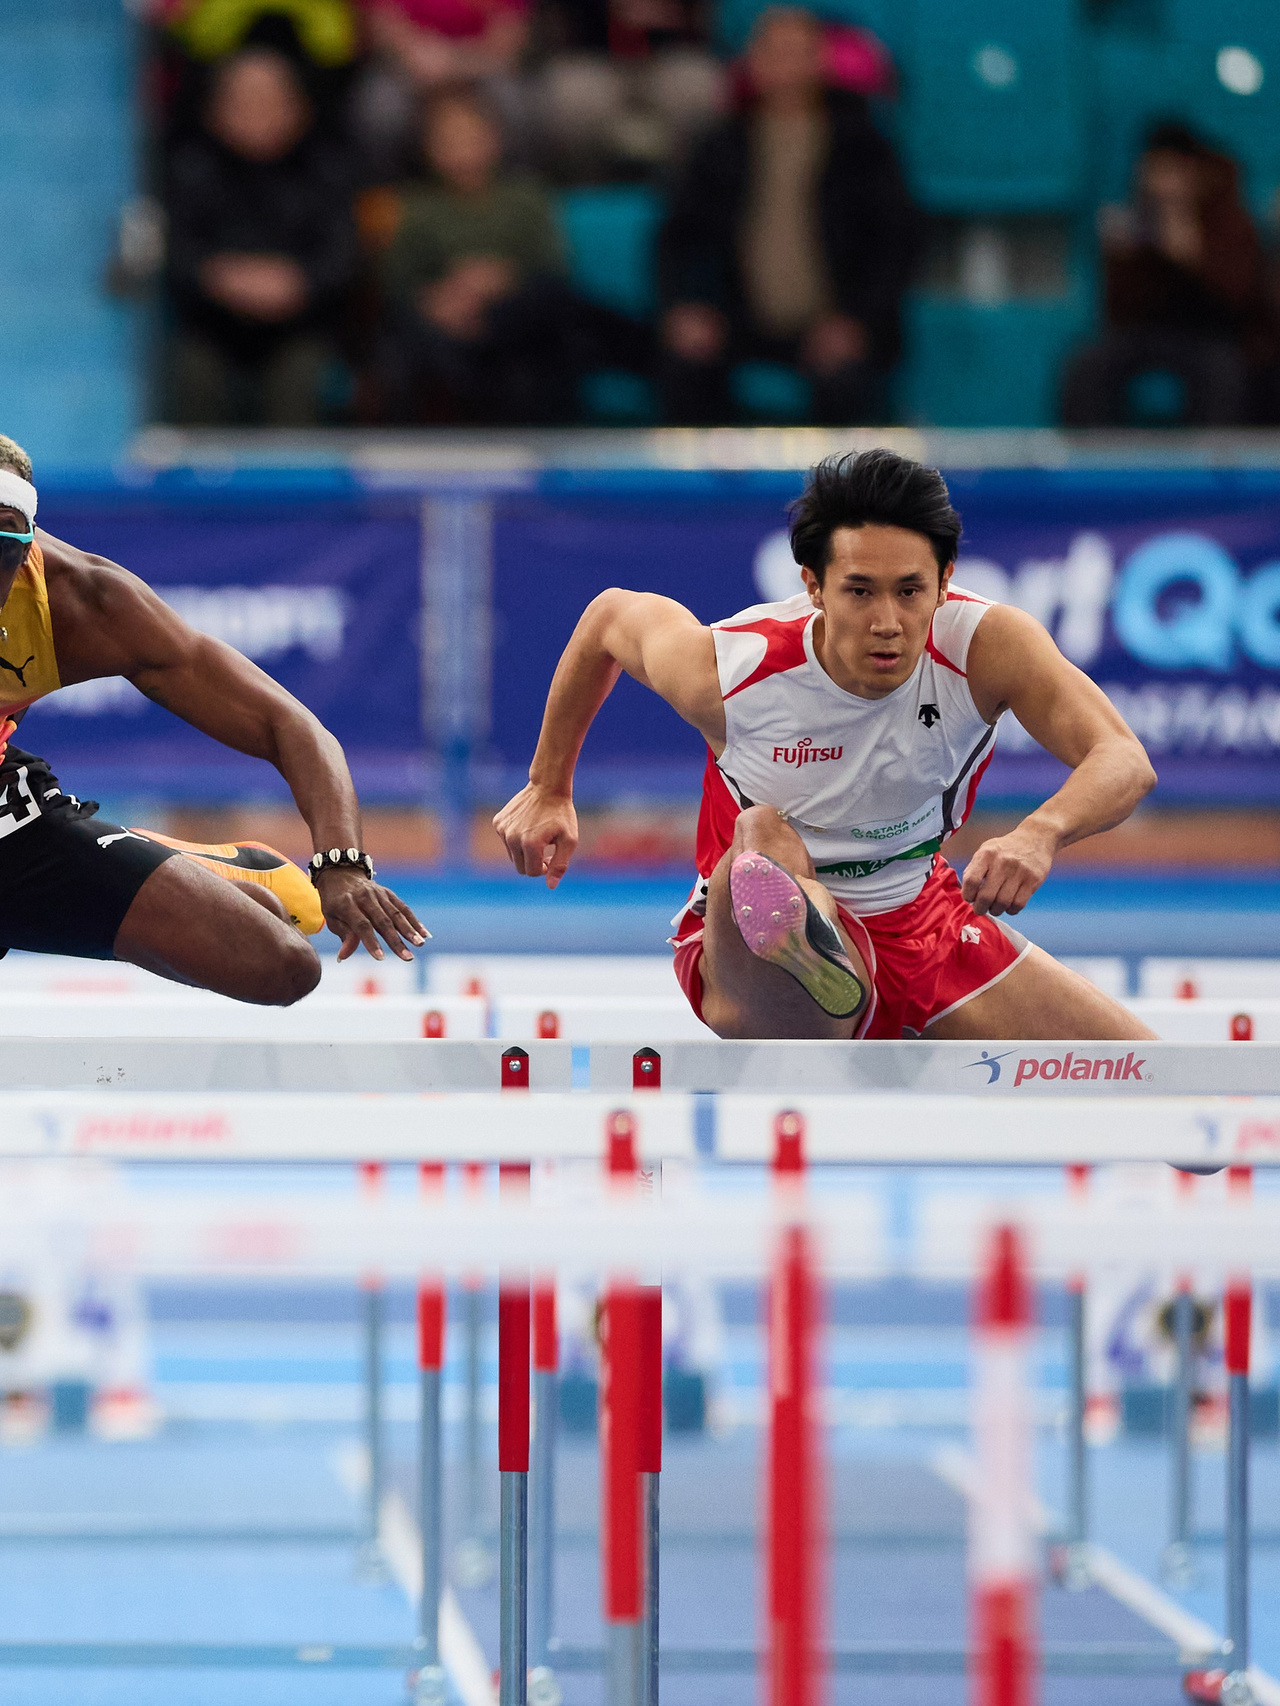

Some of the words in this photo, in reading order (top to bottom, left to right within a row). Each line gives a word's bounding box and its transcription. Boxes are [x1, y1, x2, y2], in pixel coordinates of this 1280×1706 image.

[773, 738, 843, 768] FUJITSU
[866, 825, 910, 840] INDOOR
[911, 806, 937, 828] MEET
[866, 821, 909, 835] ASTANA
[1013, 1051, 1147, 1087] polanik
